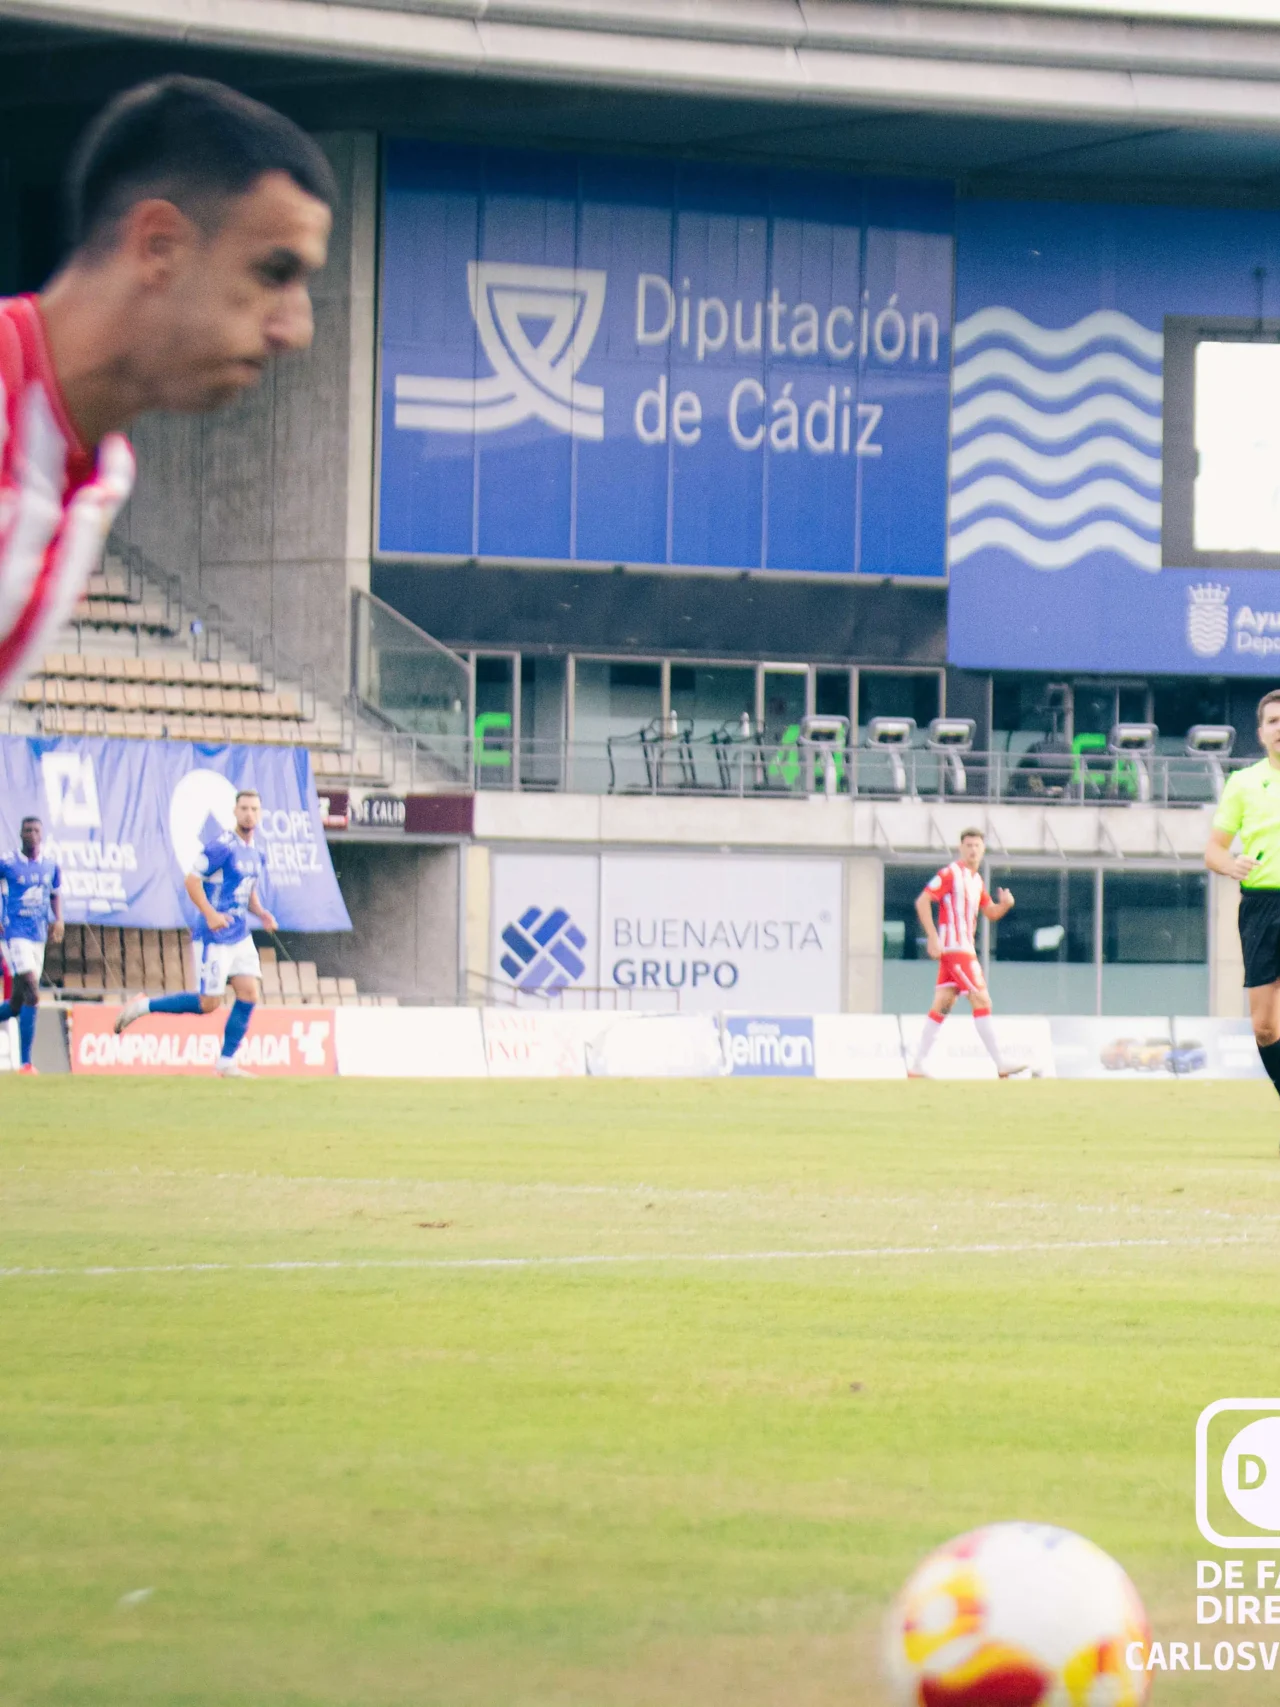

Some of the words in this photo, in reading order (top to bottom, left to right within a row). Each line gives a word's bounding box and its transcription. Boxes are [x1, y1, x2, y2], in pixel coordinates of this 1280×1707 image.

[635, 271, 939, 362] Diputación
[634, 375, 702, 445] de
[728, 376, 885, 456] Cádiz
[259, 809, 315, 841] COPE
[266, 841, 324, 873] JEREZ
[613, 917, 824, 950] BUENAVISTA
[612, 958, 739, 989] GRUPO
[80, 1032, 291, 1067] COMPRALAENRADA
